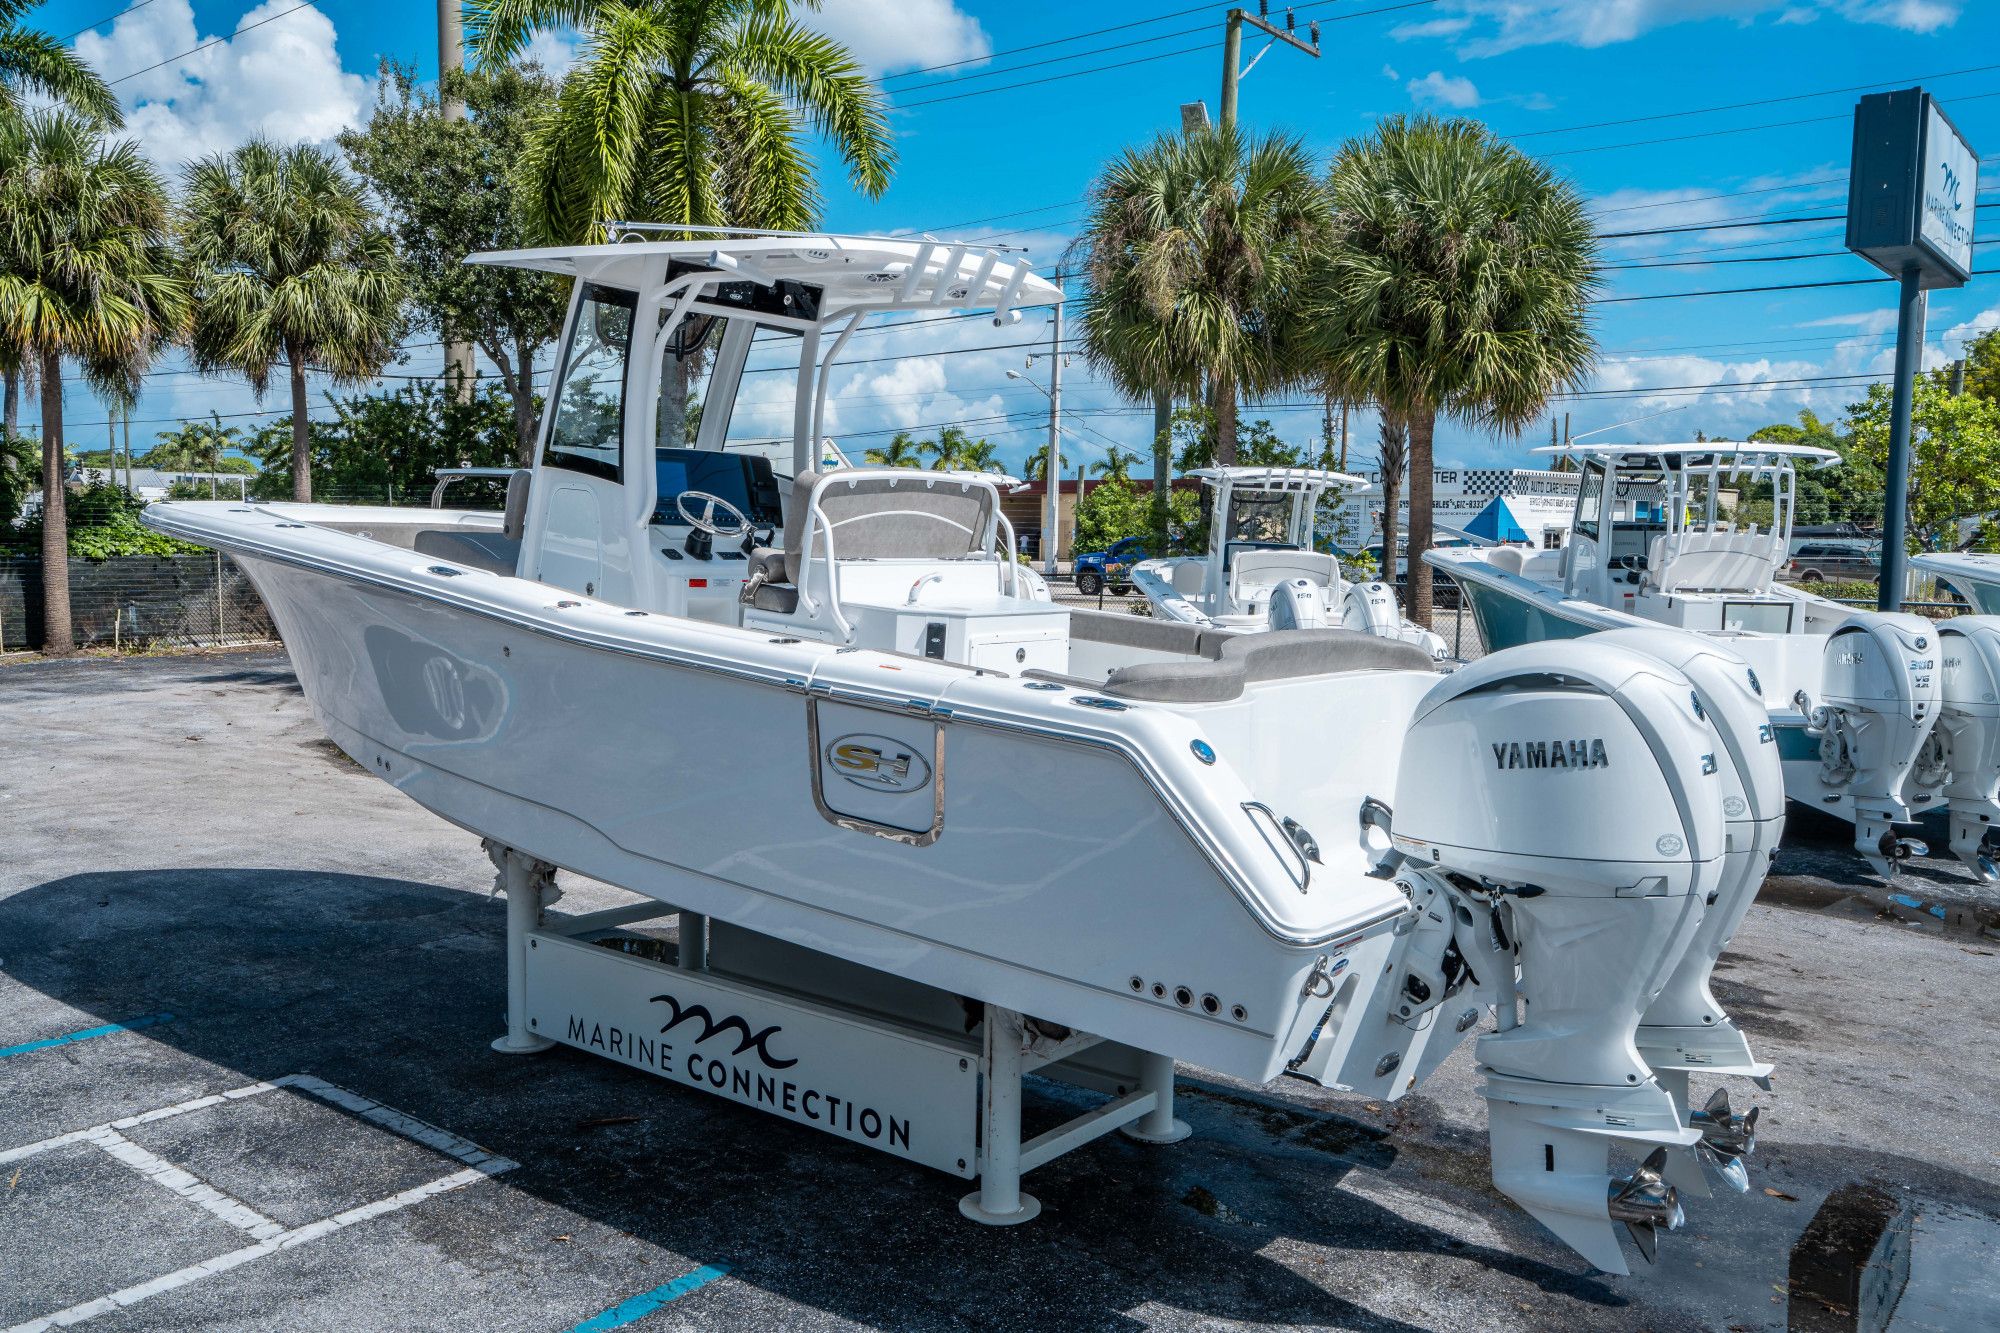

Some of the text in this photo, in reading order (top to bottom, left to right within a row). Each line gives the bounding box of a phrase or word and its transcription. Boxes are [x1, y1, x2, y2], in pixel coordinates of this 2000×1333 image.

[1433, 471, 1458, 484] TER
[1531, 481, 1544, 493] AUTO
[1546, 481, 1560, 494] CARE
[1492, 737, 1609, 770] YAMAHA
[568, 1014, 911, 1152] MARINE CONNECTION
